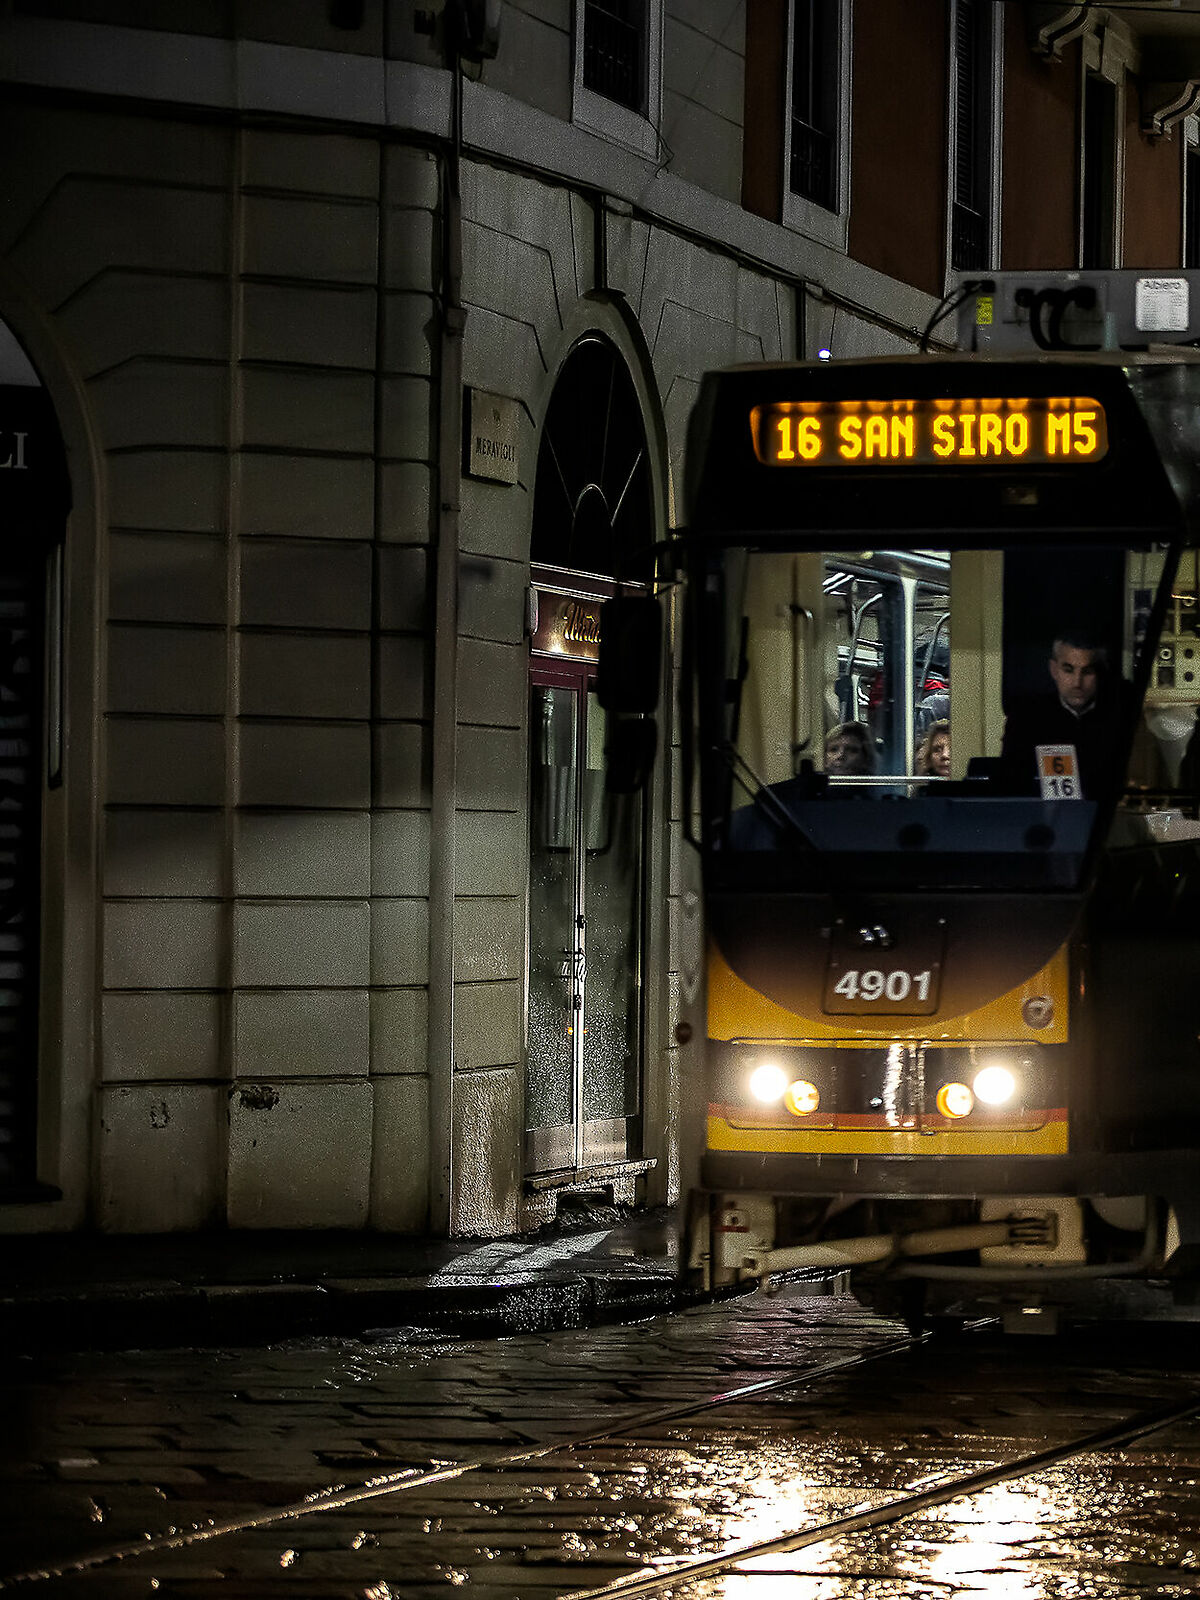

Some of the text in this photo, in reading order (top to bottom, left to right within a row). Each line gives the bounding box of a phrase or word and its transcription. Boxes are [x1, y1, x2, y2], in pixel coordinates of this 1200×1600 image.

[777, 411, 1097, 459] 16 SAN SIRO M5
[1053, 756, 1065, 774] 6
[1049, 779, 1074, 797] 16
[833, 970, 932, 1001] 4901
